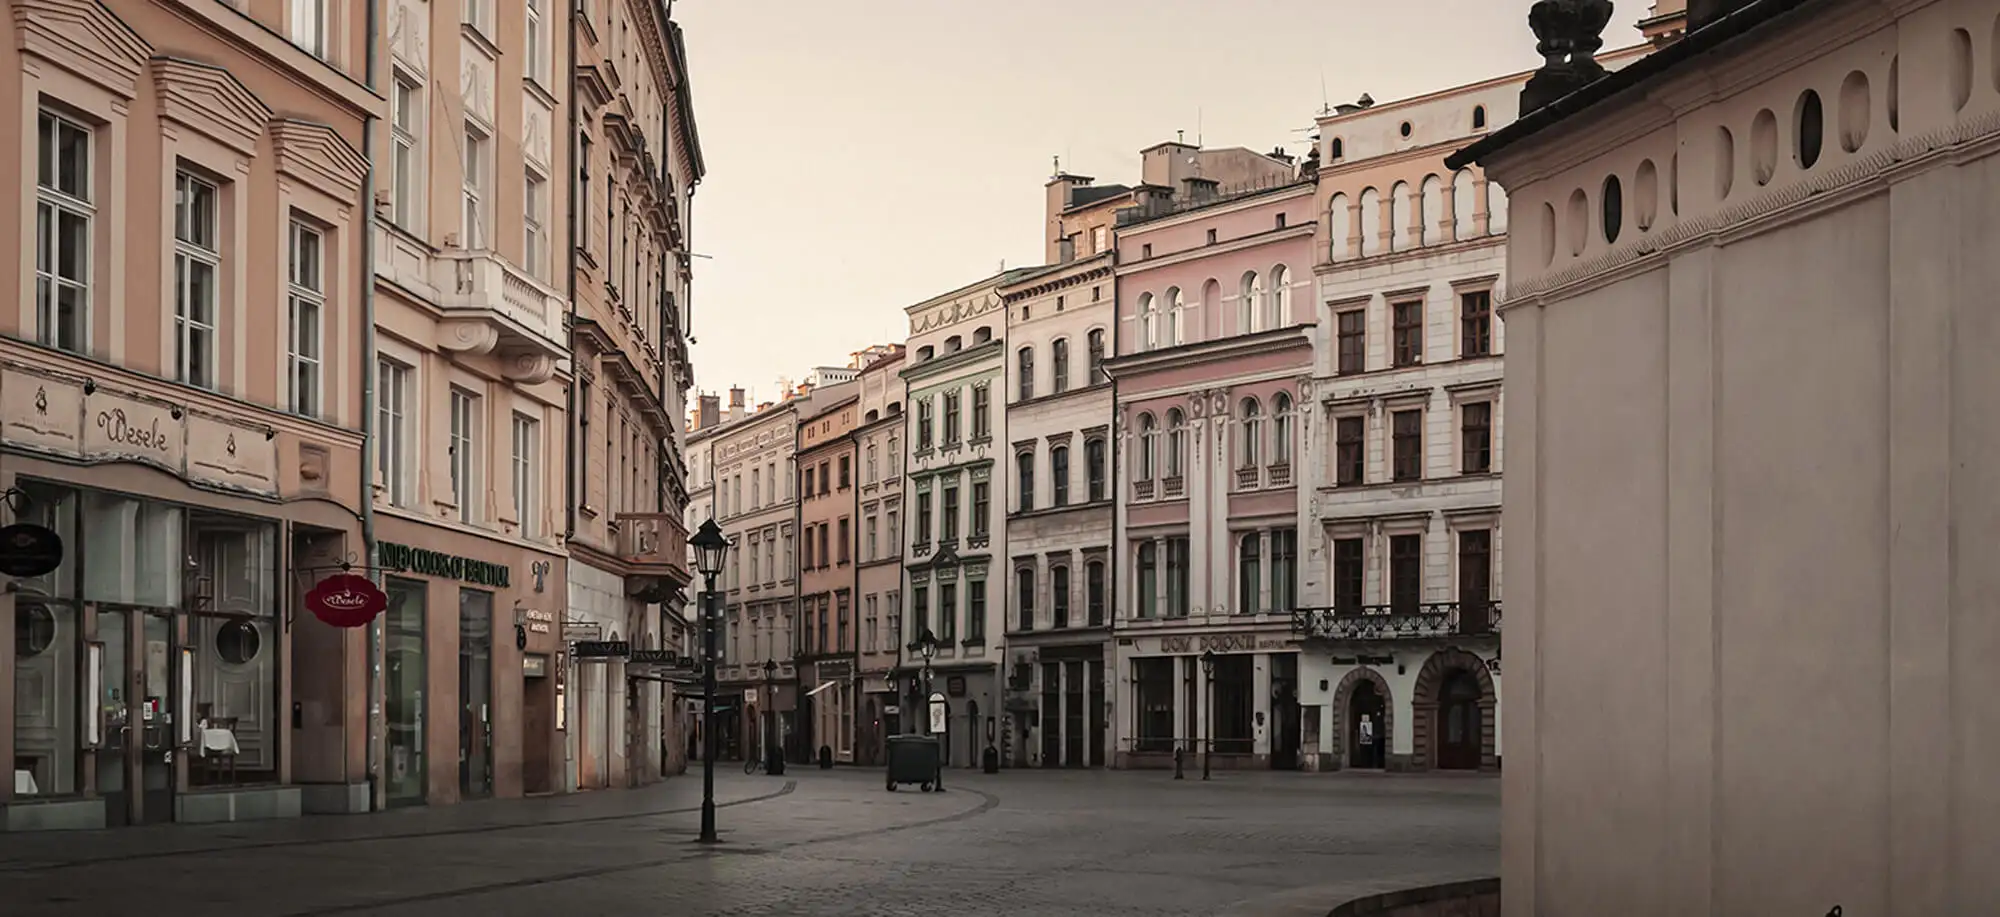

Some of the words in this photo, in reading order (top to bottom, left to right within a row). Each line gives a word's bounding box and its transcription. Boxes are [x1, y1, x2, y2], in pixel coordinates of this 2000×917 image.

[97, 407, 168, 452] Wesele
[378, 540, 410, 569] NITED
[326, 594, 365, 606] Wesele
